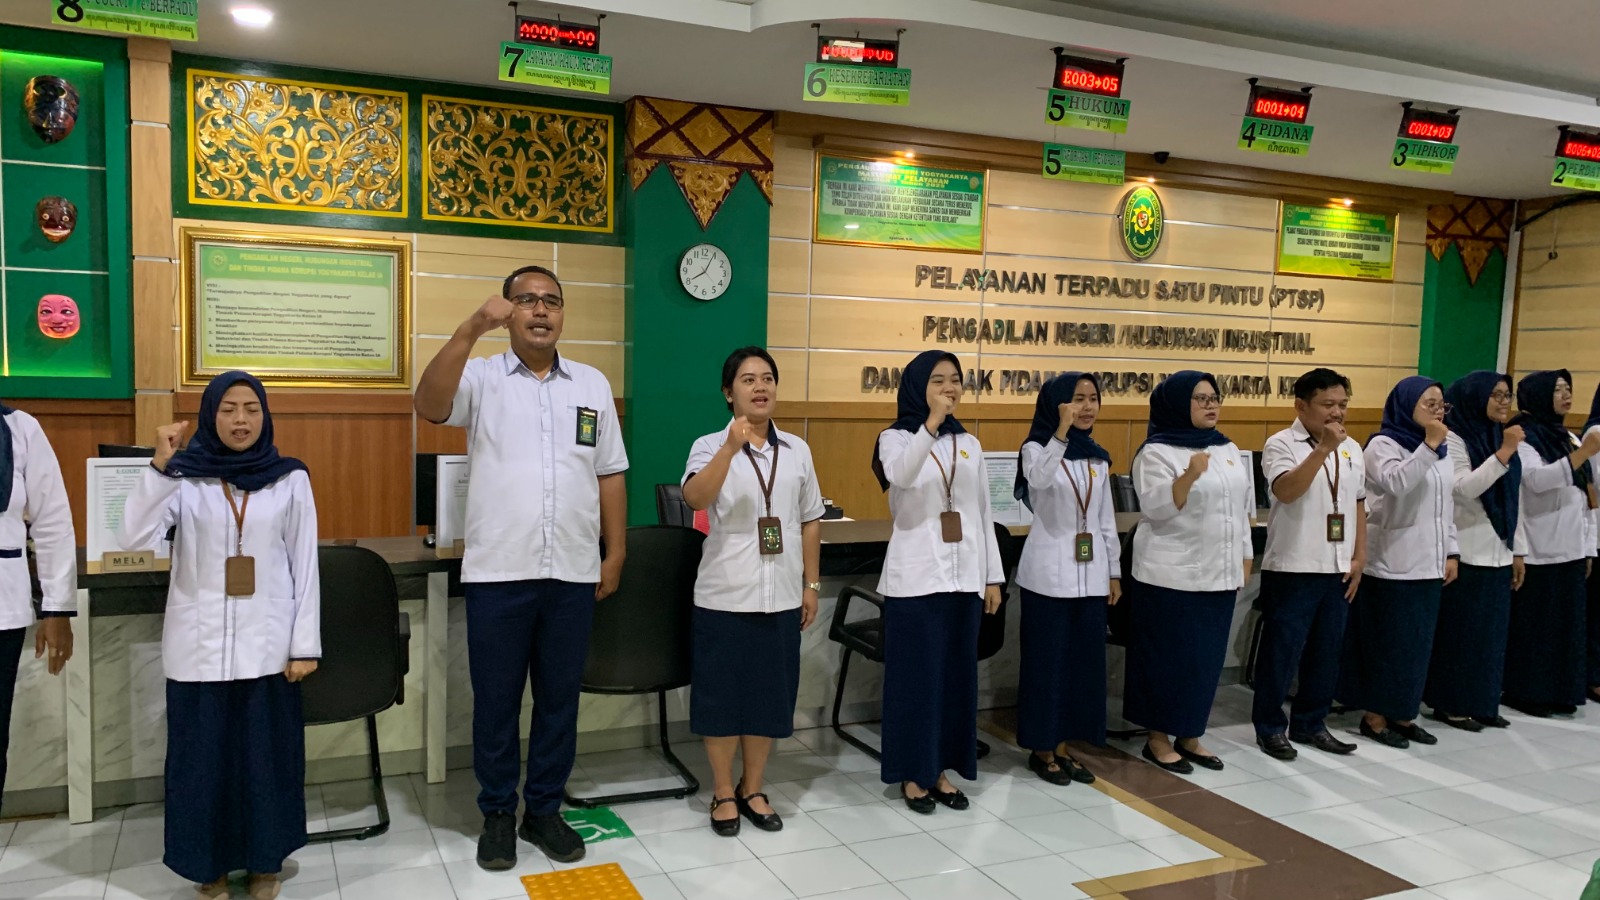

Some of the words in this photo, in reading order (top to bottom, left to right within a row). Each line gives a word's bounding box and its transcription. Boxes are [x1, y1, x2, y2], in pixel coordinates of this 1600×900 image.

[504, 46, 525, 77] 7
[807, 68, 827, 97] 6
[1048, 95, 1066, 121] 5
[1068, 96, 1126, 116] HUKUM
[1242, 122, 1256, 148] 4
[1259, 123, 1309, 141] PIDANA
[1045, 149, 1061, 175] 5
[1393, 143, 1408, 166] 3
[1410, 144, 1456, 159] TIPIKOR
[921, 171, 969, 180] YOGYAKARTA
[1554, 162, 1566, 183] 2
[686, 258, 693, 266] 10
[915, 265, 1047, 294] PELAYANAN
[1054, 274, 1150, 299] TERPADU
[1155, 280, 1206, 303] SATU
[1208, 283, 1264, 306] PINTU
[1269, 285, 1325, 313] (PTSP)
[923, 315, 1048, 345] PENGADILAN
[1054, 321, 1116, 348] NEGERI
[1222, 328, 1315, 355] INDUSTRIAL
[113, 557, 145, 565] MELA
